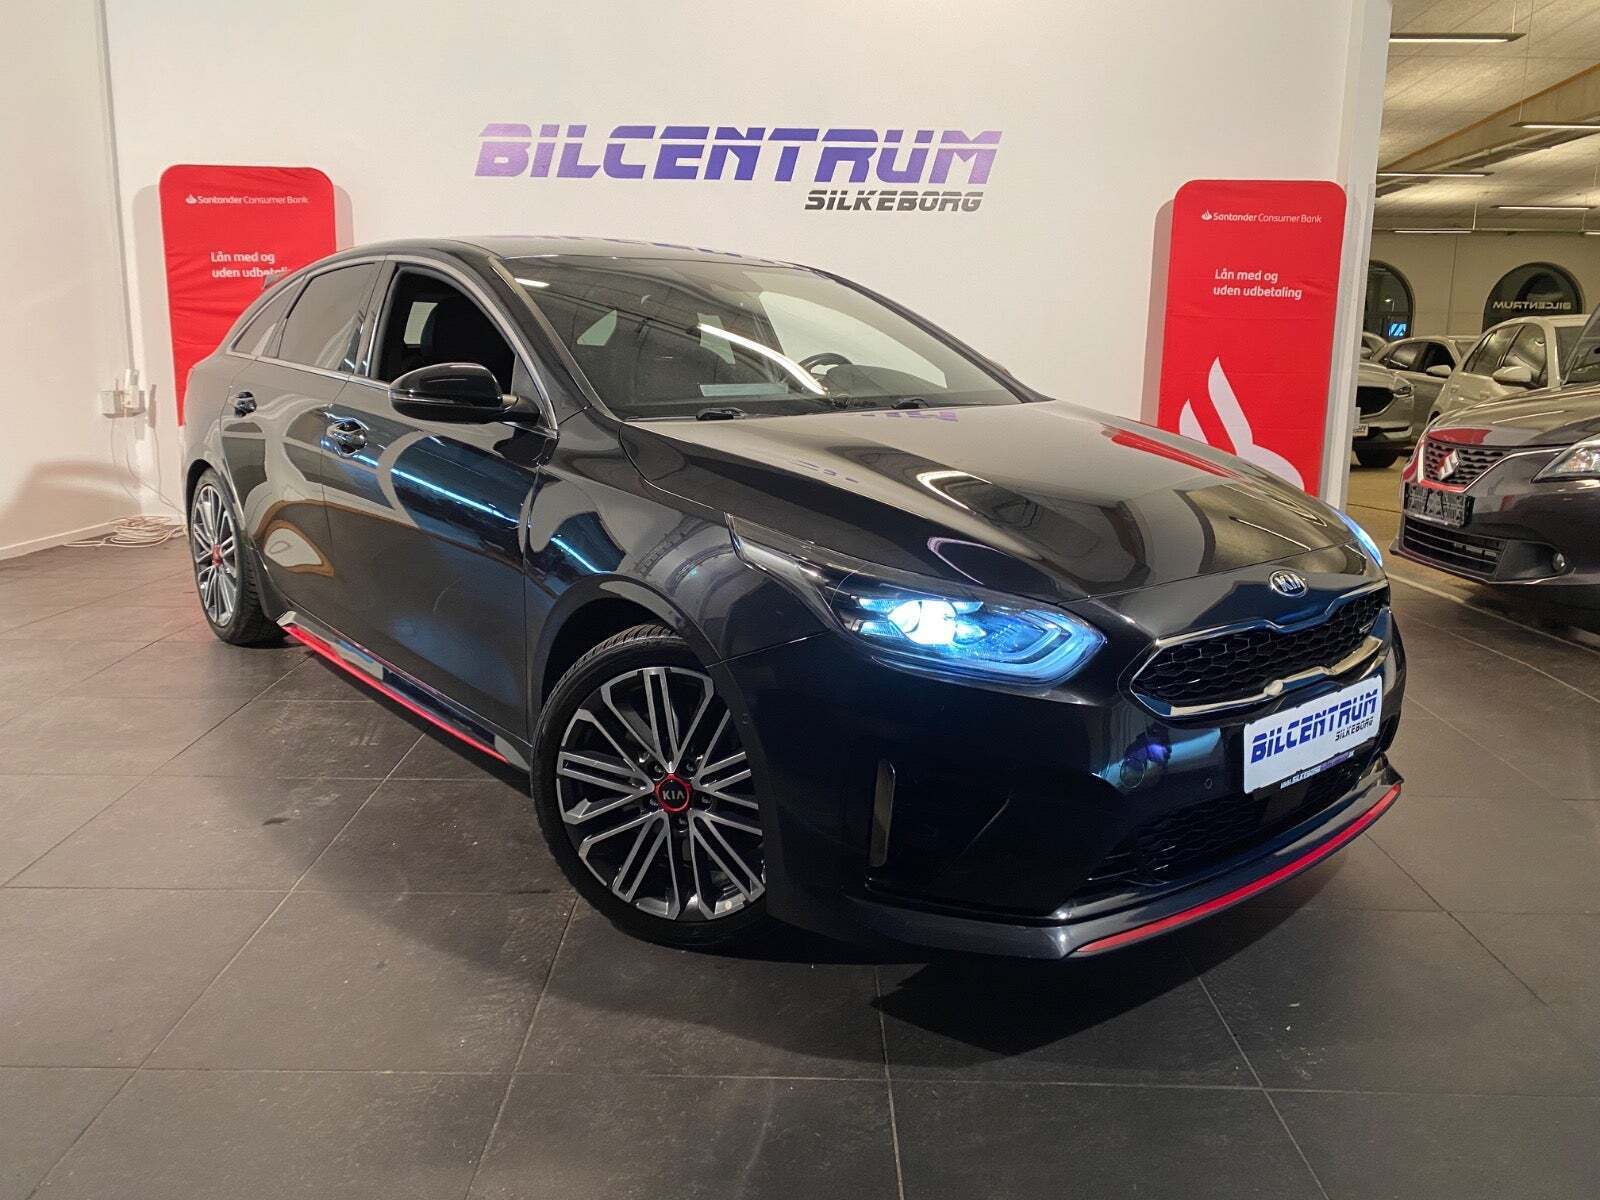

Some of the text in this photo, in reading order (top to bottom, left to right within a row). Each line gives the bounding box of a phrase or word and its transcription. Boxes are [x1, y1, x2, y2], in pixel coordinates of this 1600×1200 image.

[474, 123, 1002, 185] BILCENTRUM
[198, 196, 241, 204] Santander
[287, 196, 309, 205] Bank
[804, 190, 984, 213] SILKEBORG
[1213, 212, 1322, 223] Santander Consumer Bank
[211, 251, 275, 265] Lån med og
[212, 268, 240, 278] uden
[1215, 268, 1278, 284] Lån med og
[1213, 285, 1302, 301] uden udbetaling
[1274, 574, 1305, 592] KIA
[1250, 688, 1378, 764] BILCENTRUM
[662, 790, 685, 800] KIA
